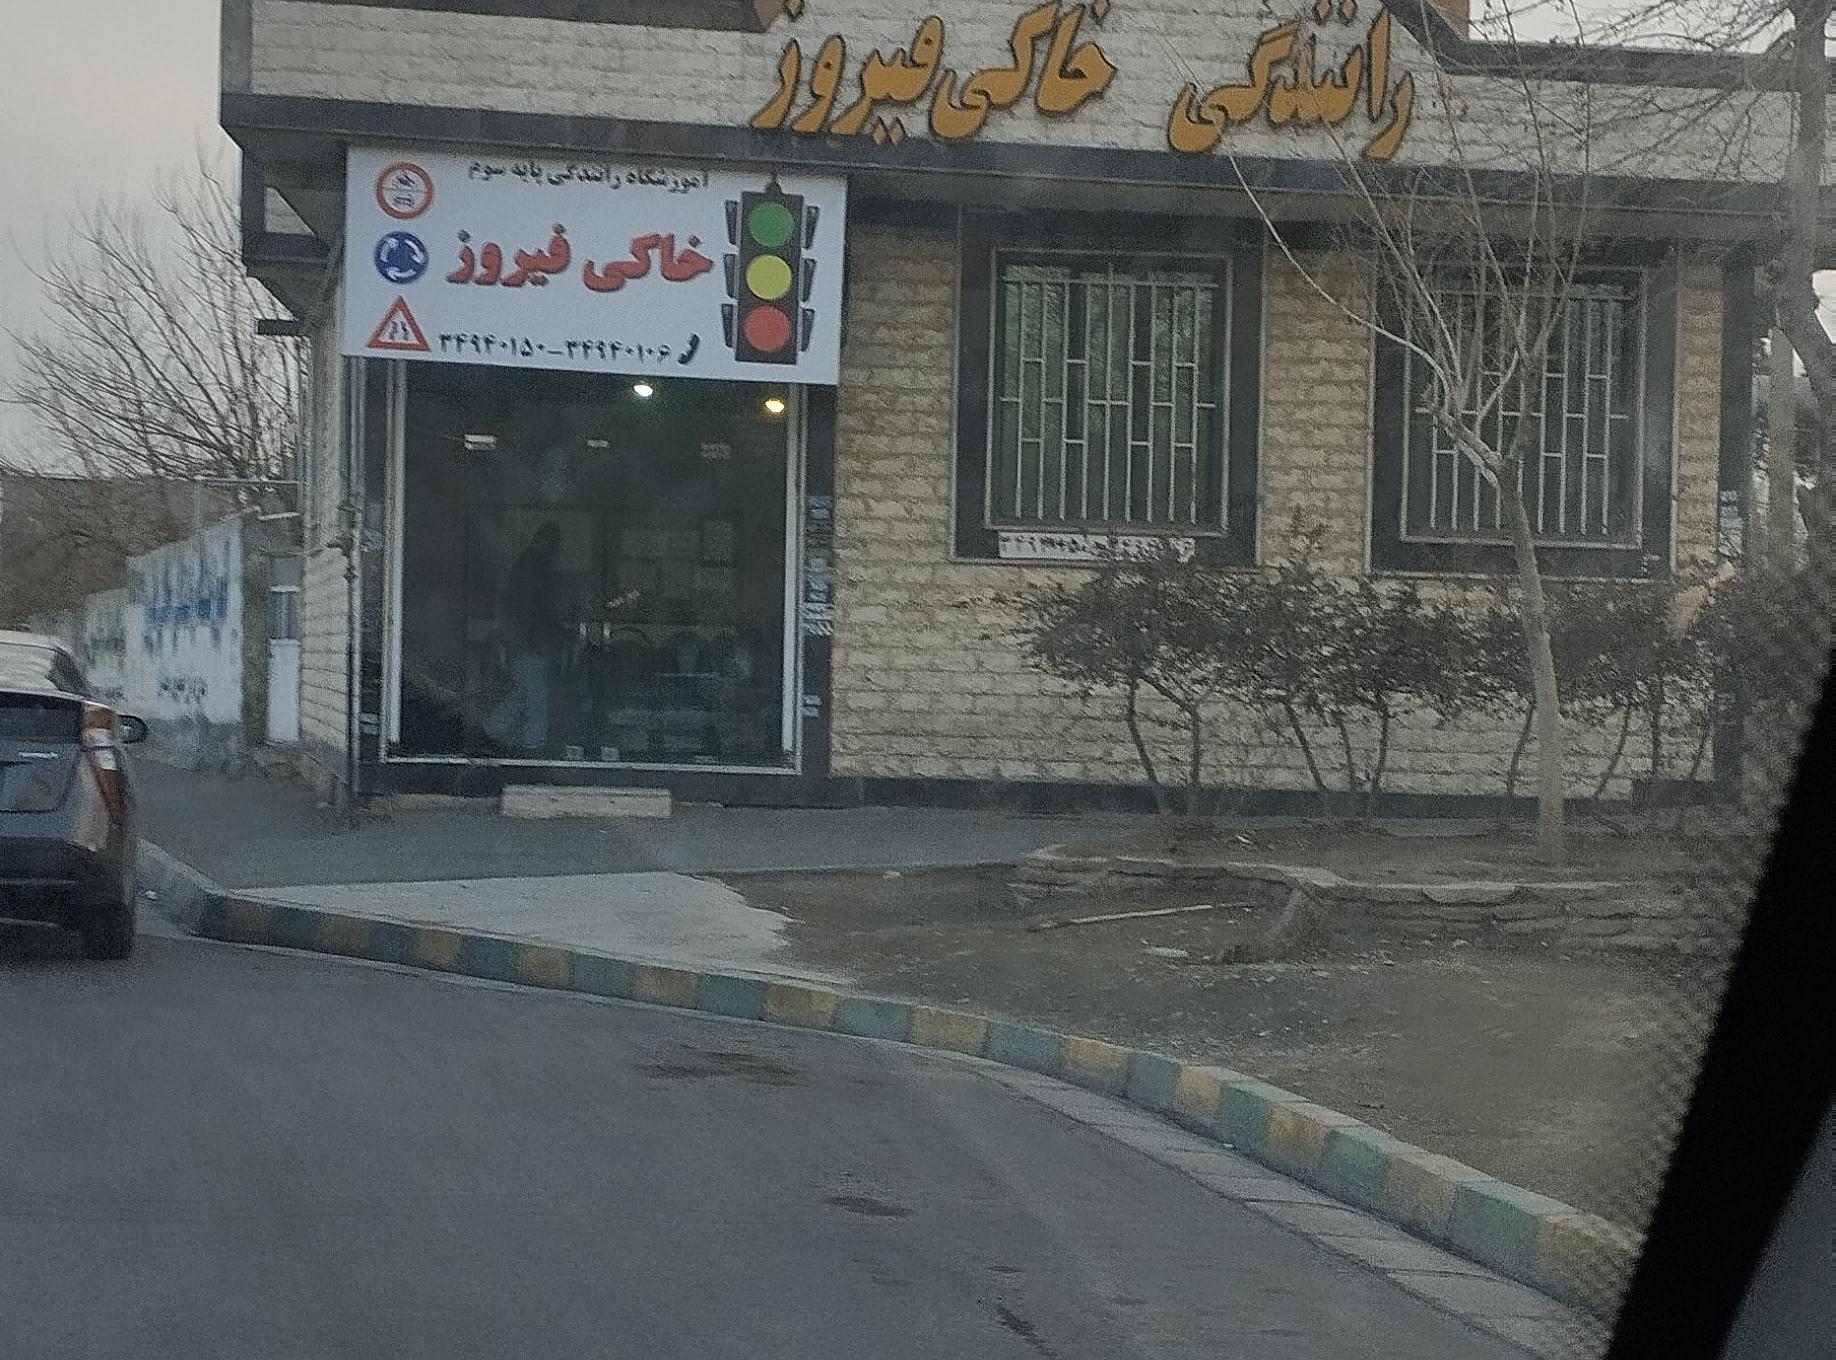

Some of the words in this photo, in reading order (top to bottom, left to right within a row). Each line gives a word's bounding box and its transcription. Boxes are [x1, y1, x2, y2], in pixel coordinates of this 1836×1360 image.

[467, 160, 505, 183] سوم
[446, 221, 571, 287] فیروز
[582, 232, 713, 293] خاکی
